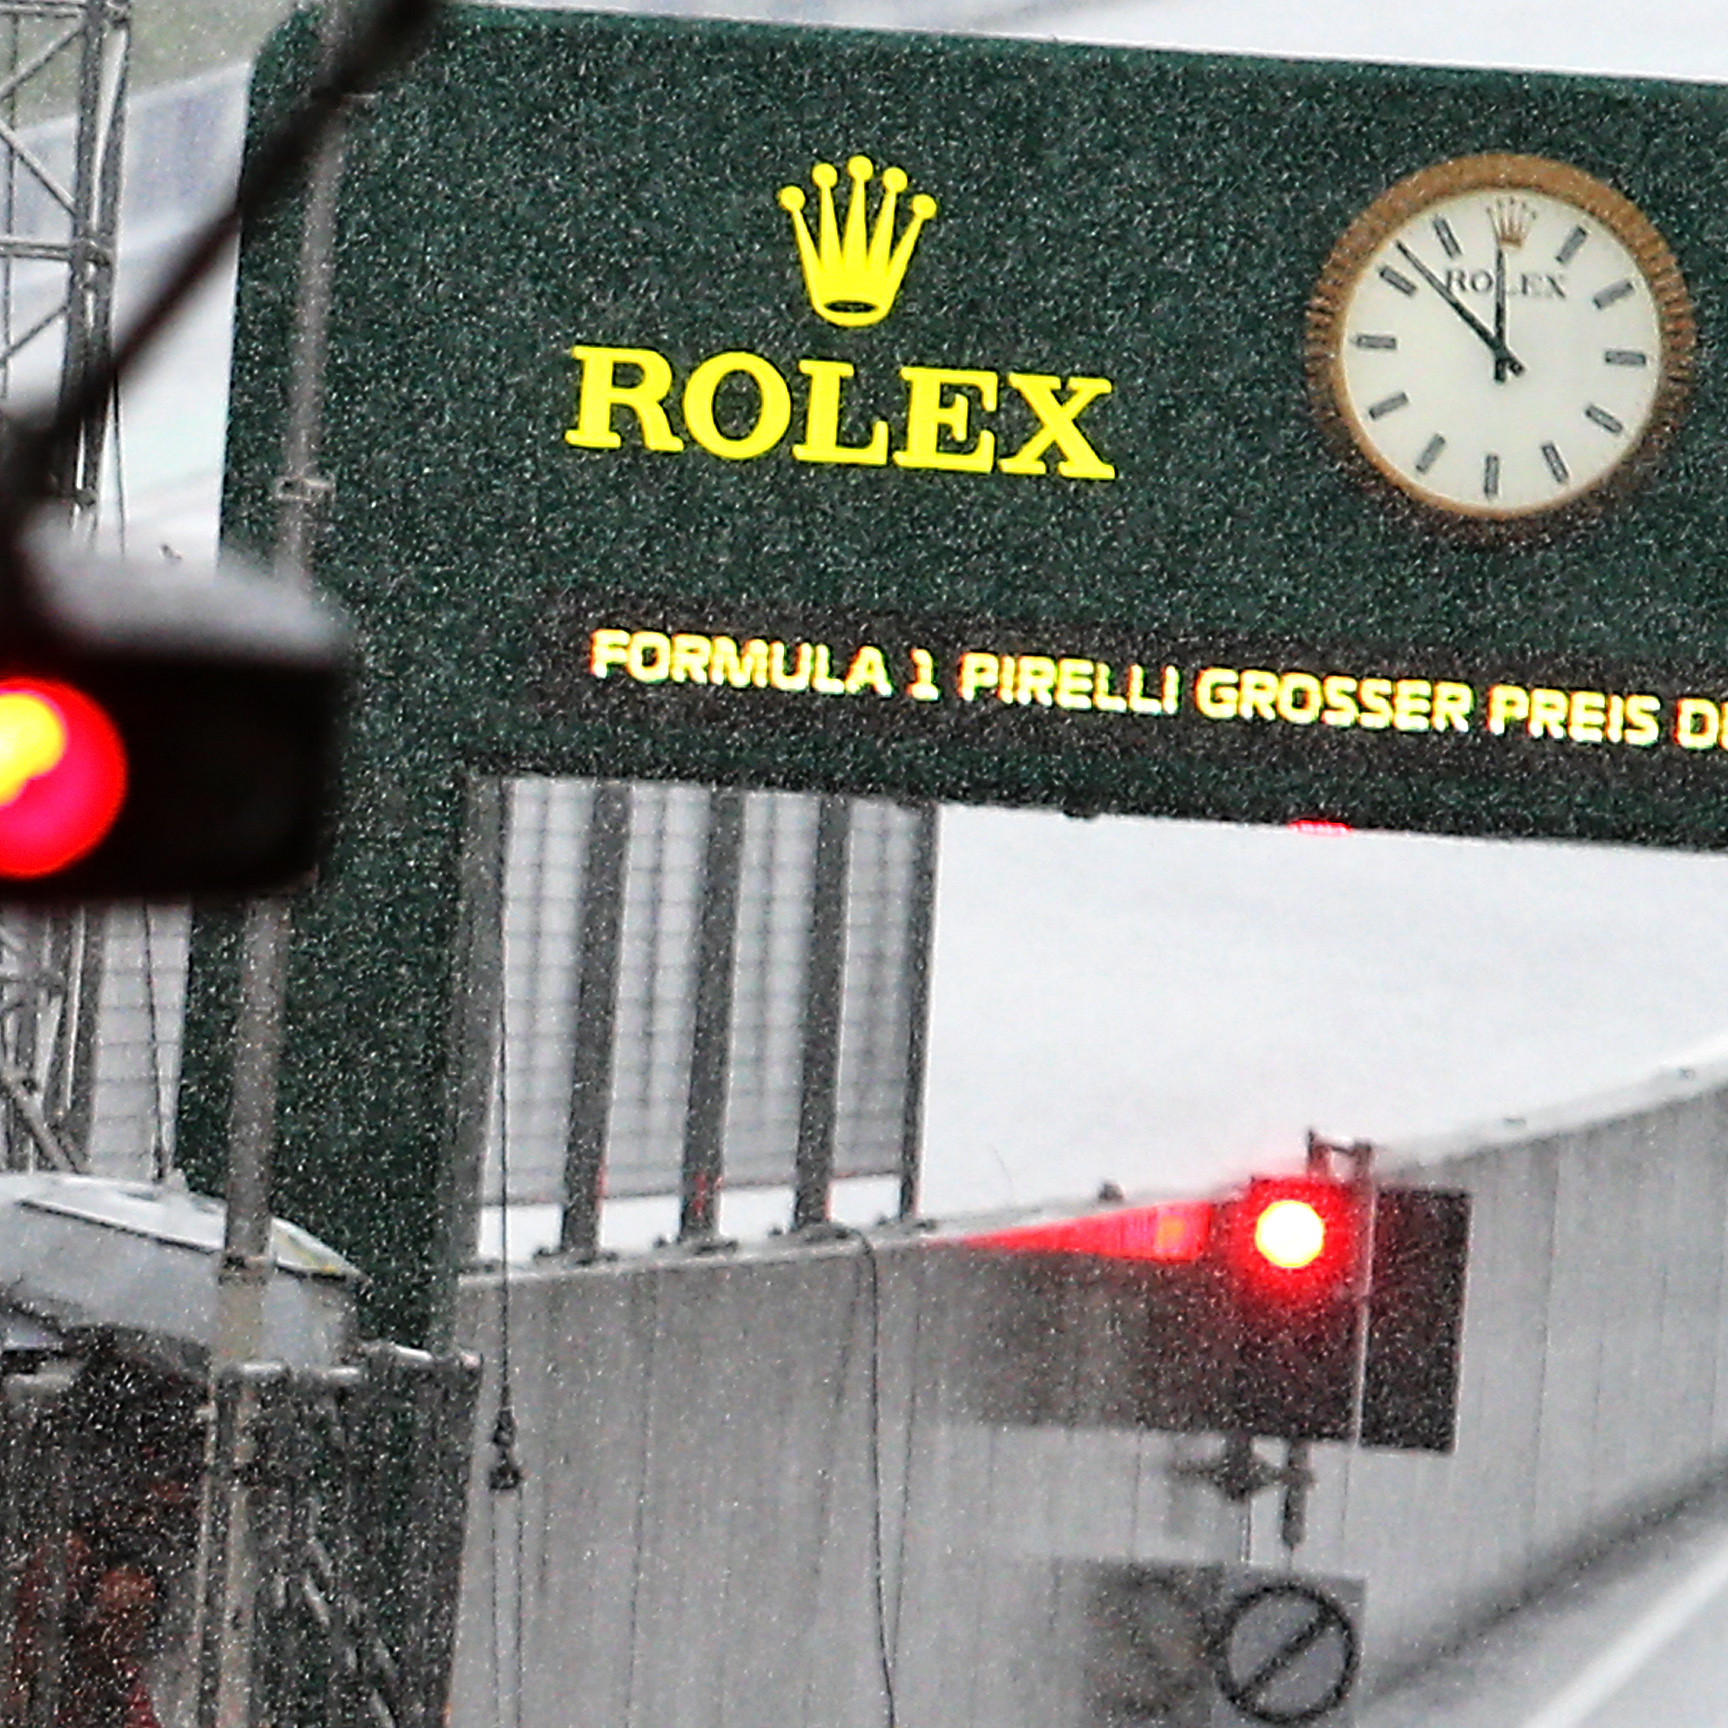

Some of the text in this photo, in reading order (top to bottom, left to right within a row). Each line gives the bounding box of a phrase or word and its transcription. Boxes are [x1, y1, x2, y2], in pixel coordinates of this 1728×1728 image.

[1444, 269, 1565, 299] ROEX
[565, 346, 1116, 481] ROLEX
[591, 628, 892, 697] FORMULA
[905, 648, 940, 701] 1
[960, 652, 1180, 715] PIRELLI
[1195, 666, 1474, 734] GROSSER
[1486, 684, 1662, 748] PREIS
